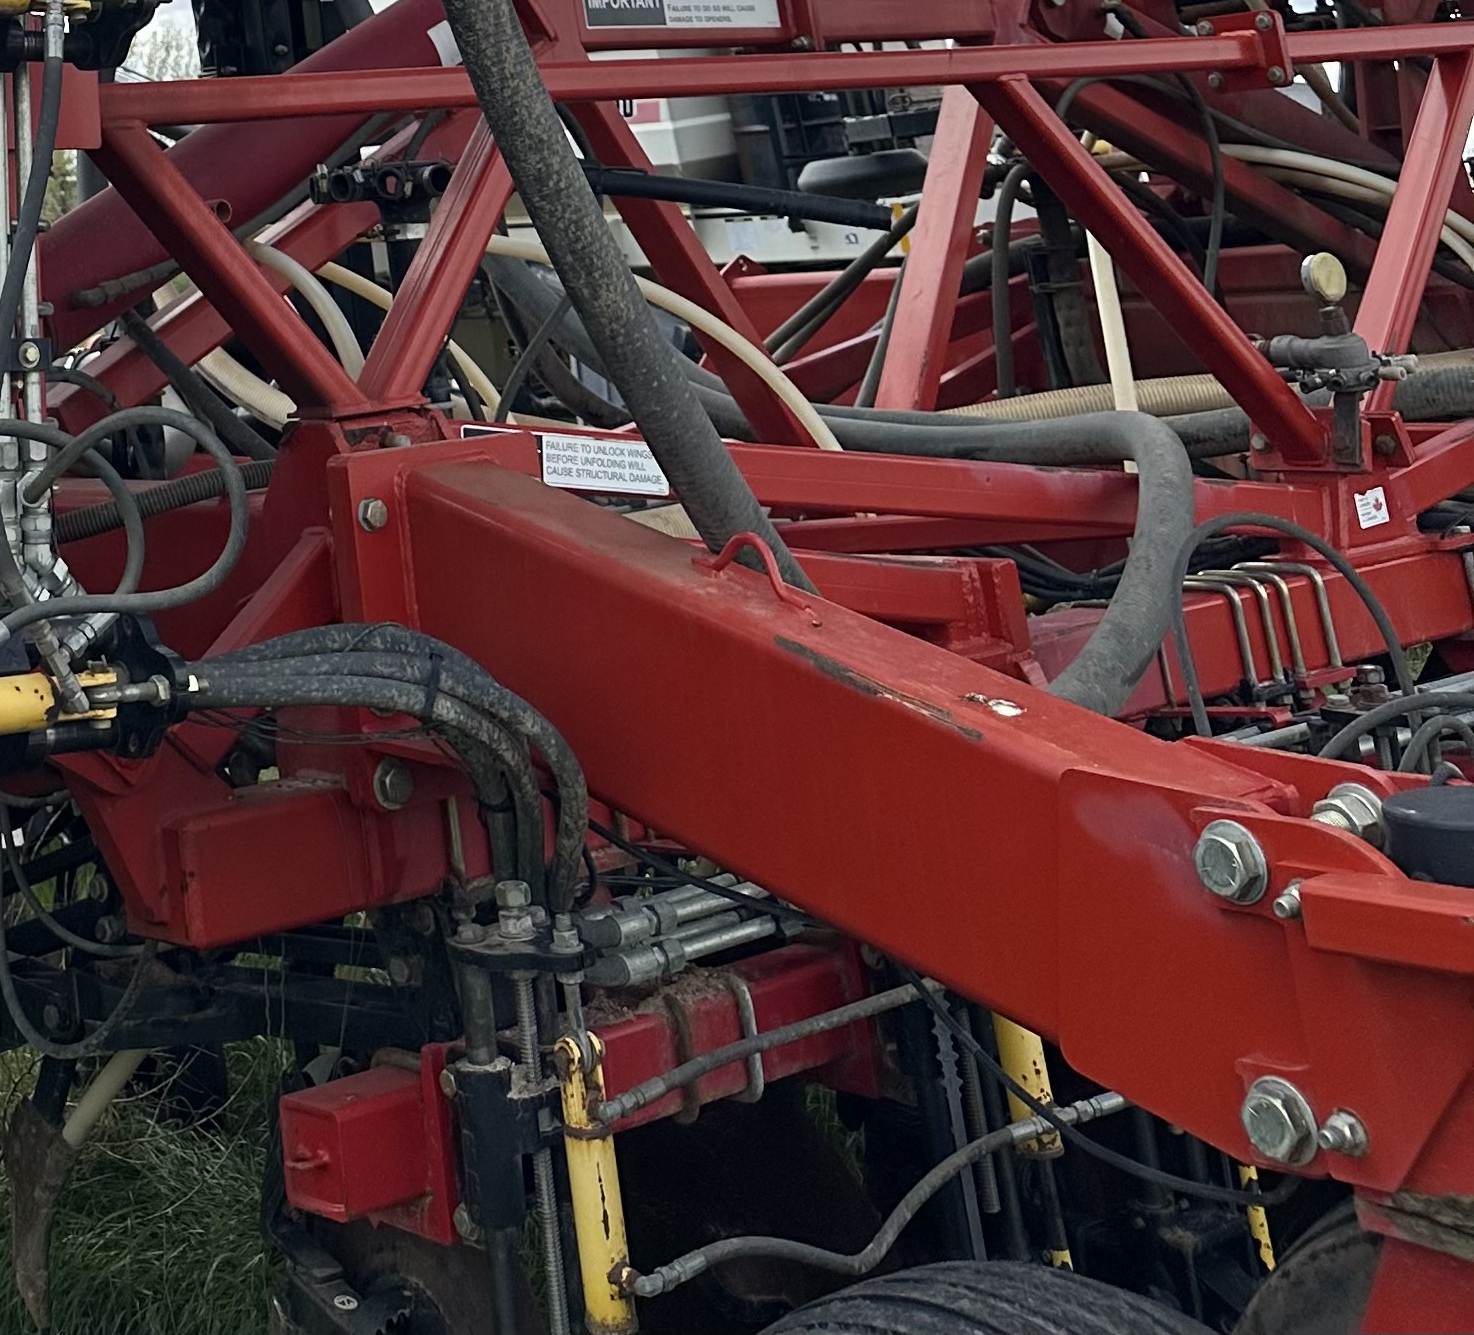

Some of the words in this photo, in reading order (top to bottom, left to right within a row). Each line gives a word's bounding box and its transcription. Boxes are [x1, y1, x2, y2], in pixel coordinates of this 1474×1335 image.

[693, 4, 702, 12] TO
[702, 4, 712, 12] DO
[722, 4, 736, 12] WILL
[694, 15, 704, 23] TO
[545, 440, 580, 454] FAILURE
[580, 443, 592, 455] TO
[592, 445, 626, 458] UNLOCK
[545, 452, 579, 466] BEFORE
[580, 456, 627, 470] UNFOLDING
[627, 460, 647, 472] WILL
[546, 465, 574, 477] CAUSE
[575, 468, 629, 482] STRUCTURAL
